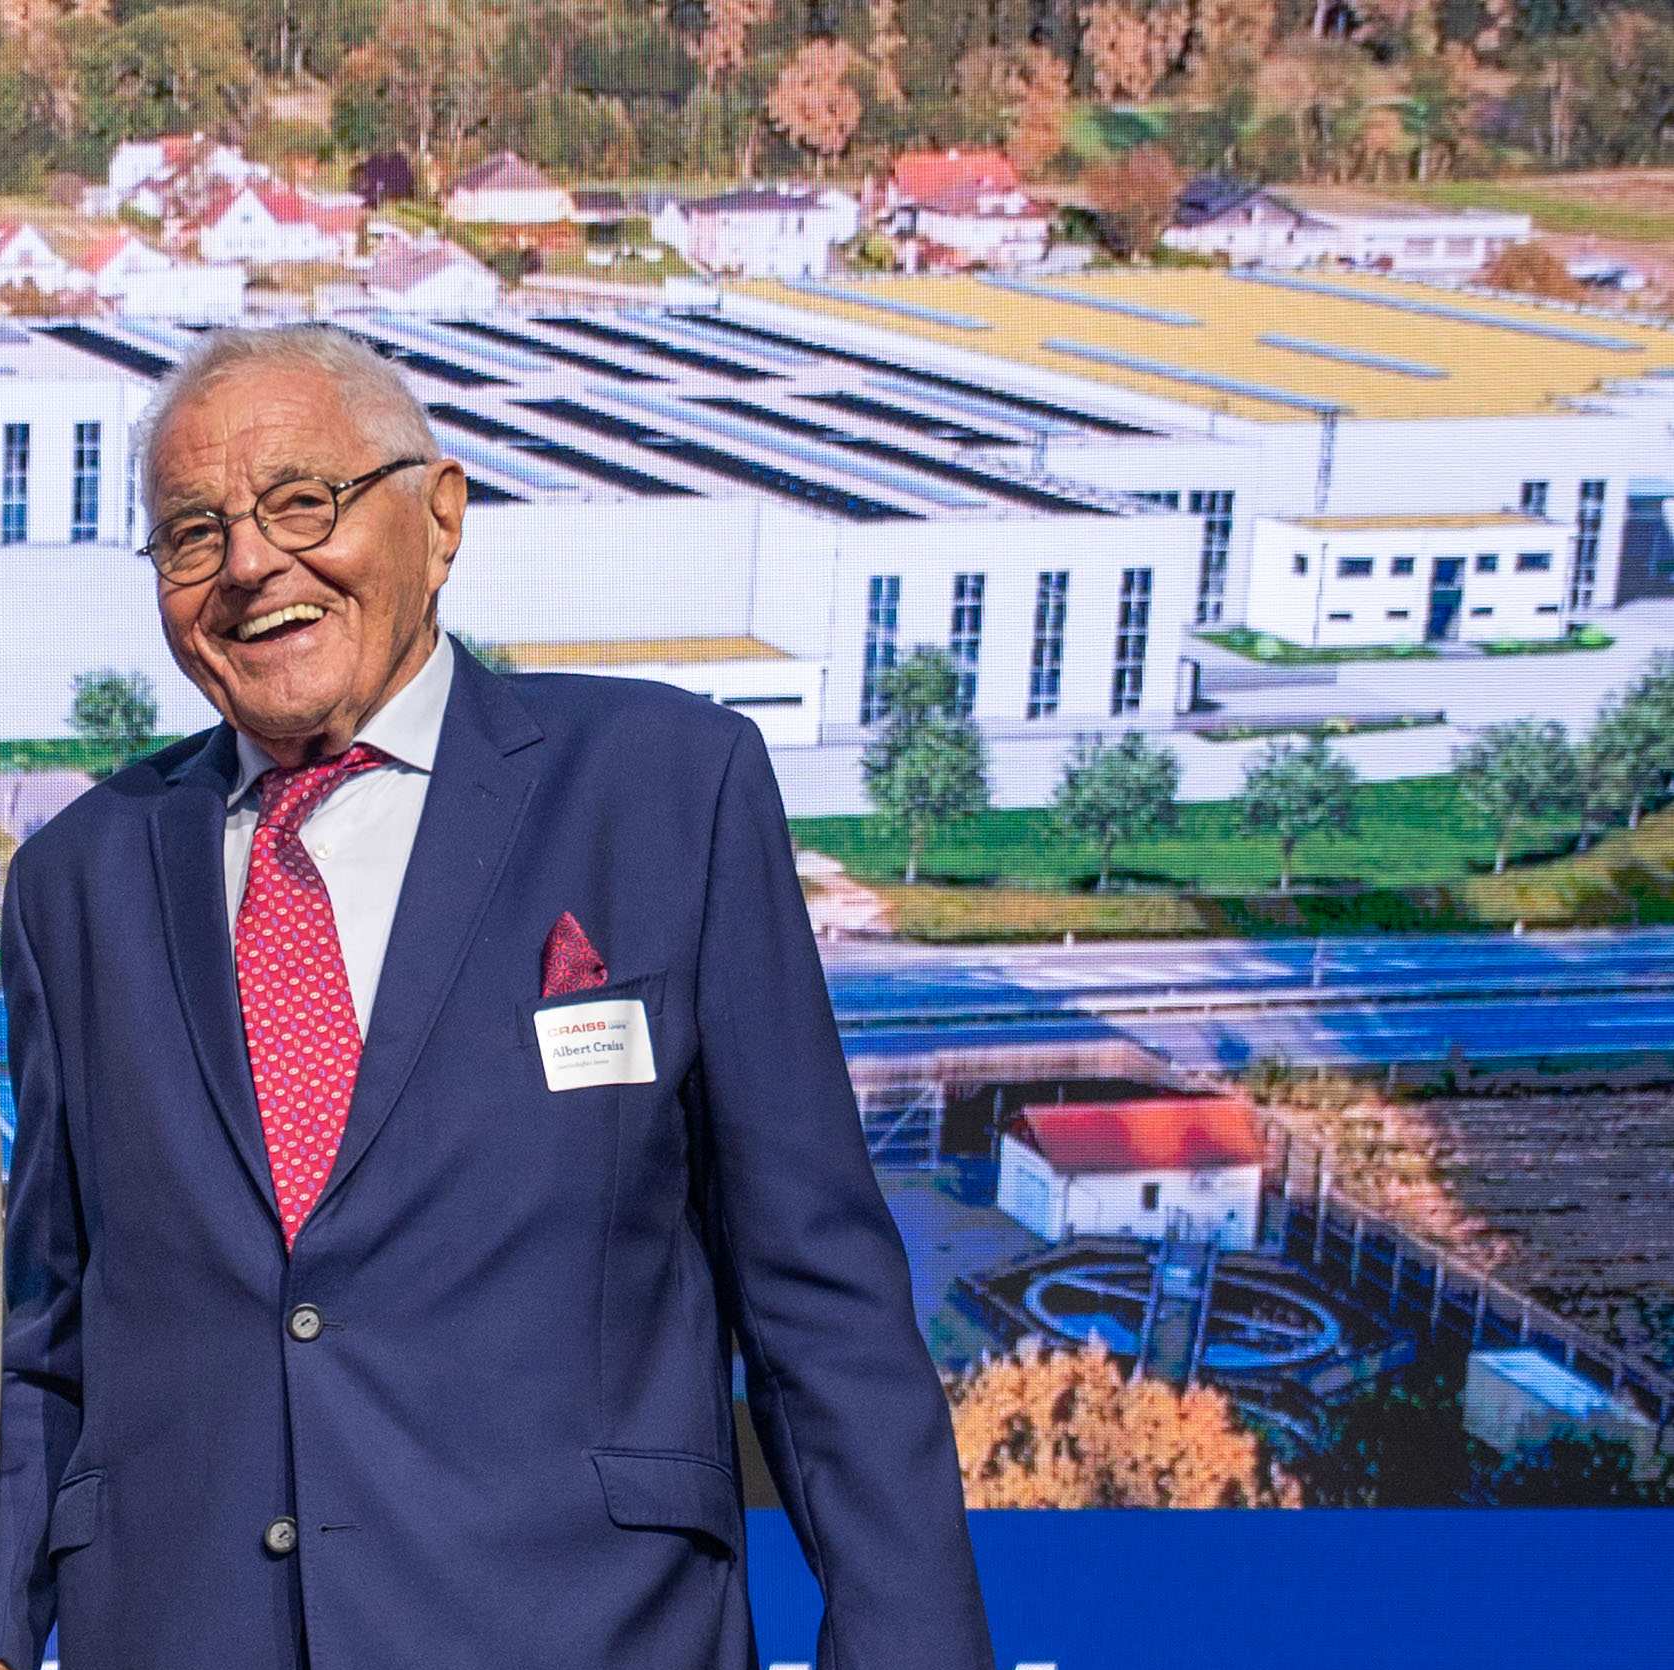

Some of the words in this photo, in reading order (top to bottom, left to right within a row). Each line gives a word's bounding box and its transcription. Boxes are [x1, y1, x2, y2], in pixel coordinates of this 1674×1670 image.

[548, 1021, 607, 1038] CRAISS
[552, 1044, 592, 1059] Albert
[593, 1040, 625, 1053] Craiss
